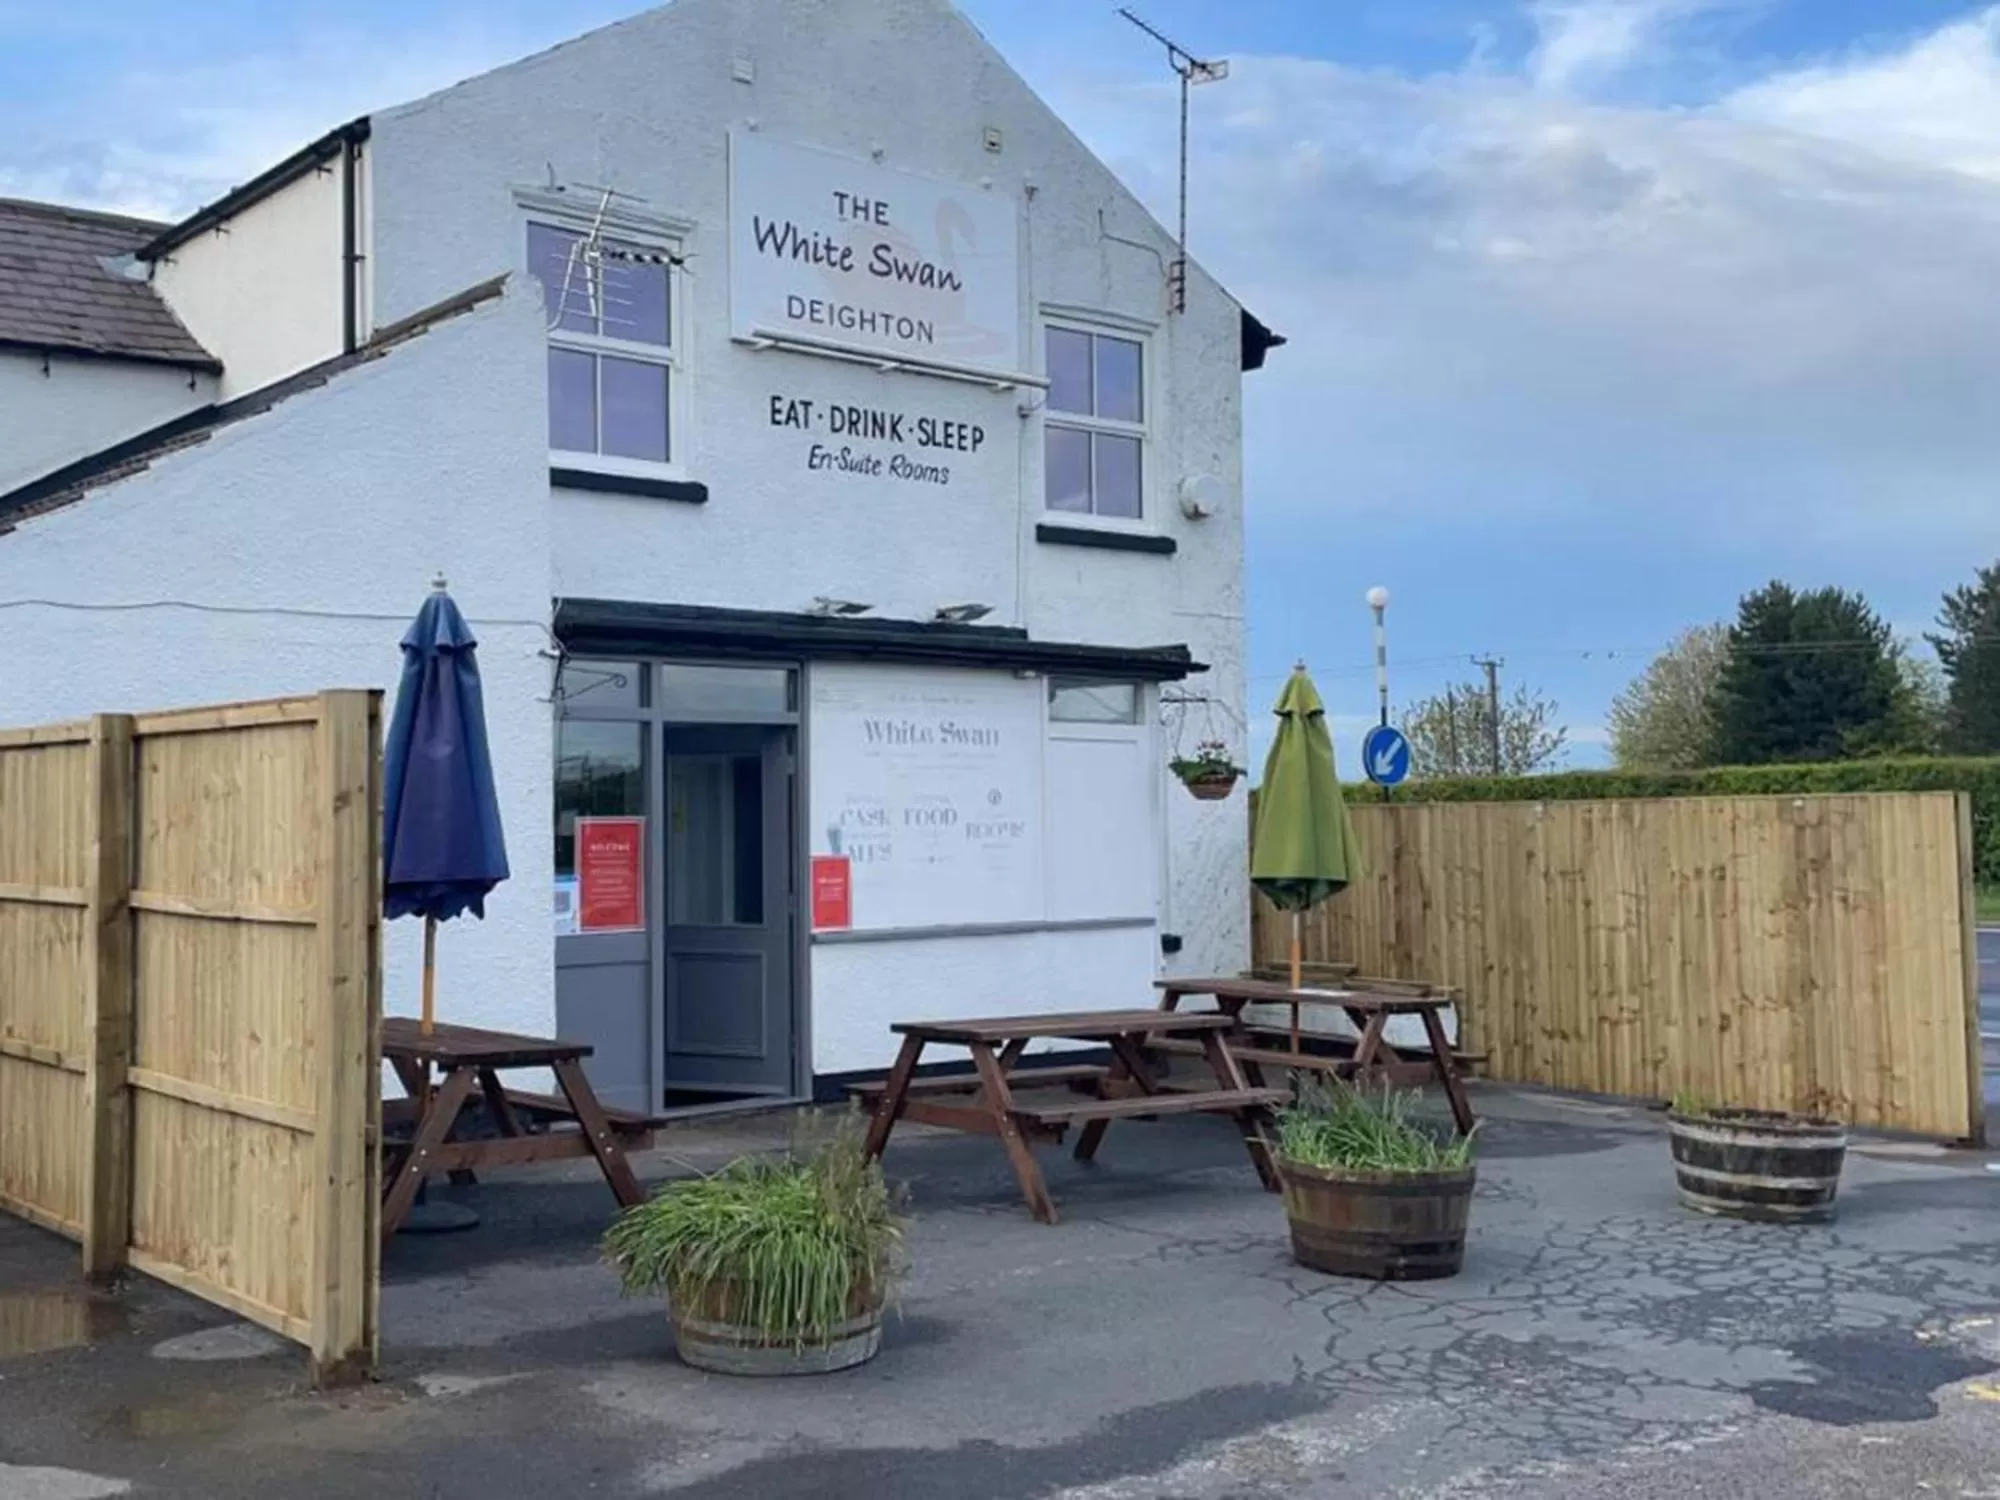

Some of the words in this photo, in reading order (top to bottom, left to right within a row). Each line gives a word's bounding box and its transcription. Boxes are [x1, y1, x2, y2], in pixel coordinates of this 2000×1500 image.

[833, 191, 890, 226] THE
[753, 215, 854, 272] White
[868, 243, 962, 292] Swan
[787, 295, 933, 343] DEIGHTON
[769, 395, 813, 430] EAT
[829, 404, 905, 442] DRINK
[917, 417, 984, 452] SLEEP
[888, 453, 950, 485] Rooms
[863, 718, 934, 746] White
[939, 719, 1000, 748] Swan
[903, 807, 958, 827] FOOD
